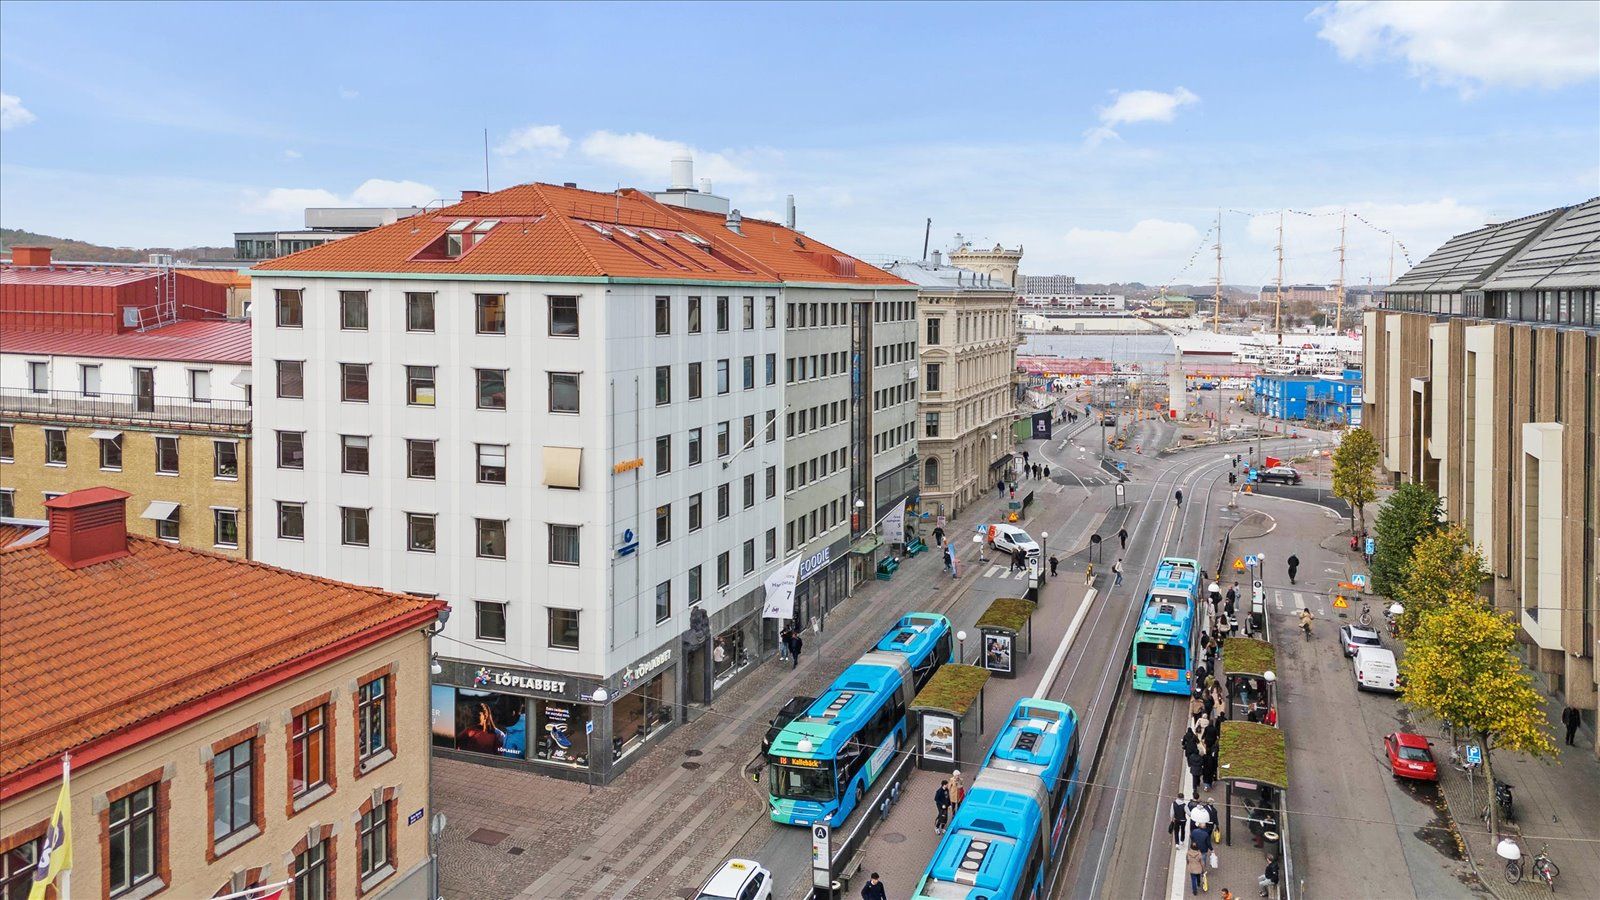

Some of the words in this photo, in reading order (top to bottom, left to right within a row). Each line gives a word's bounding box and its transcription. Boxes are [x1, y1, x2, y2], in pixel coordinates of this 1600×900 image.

[800, 547, 830, 576] FOODIE
[786, 590, 792, 600] 7
[634, 649, 672, 680] LÖPLABBET
[495, 671, 566, 693] LÖPLABBET
